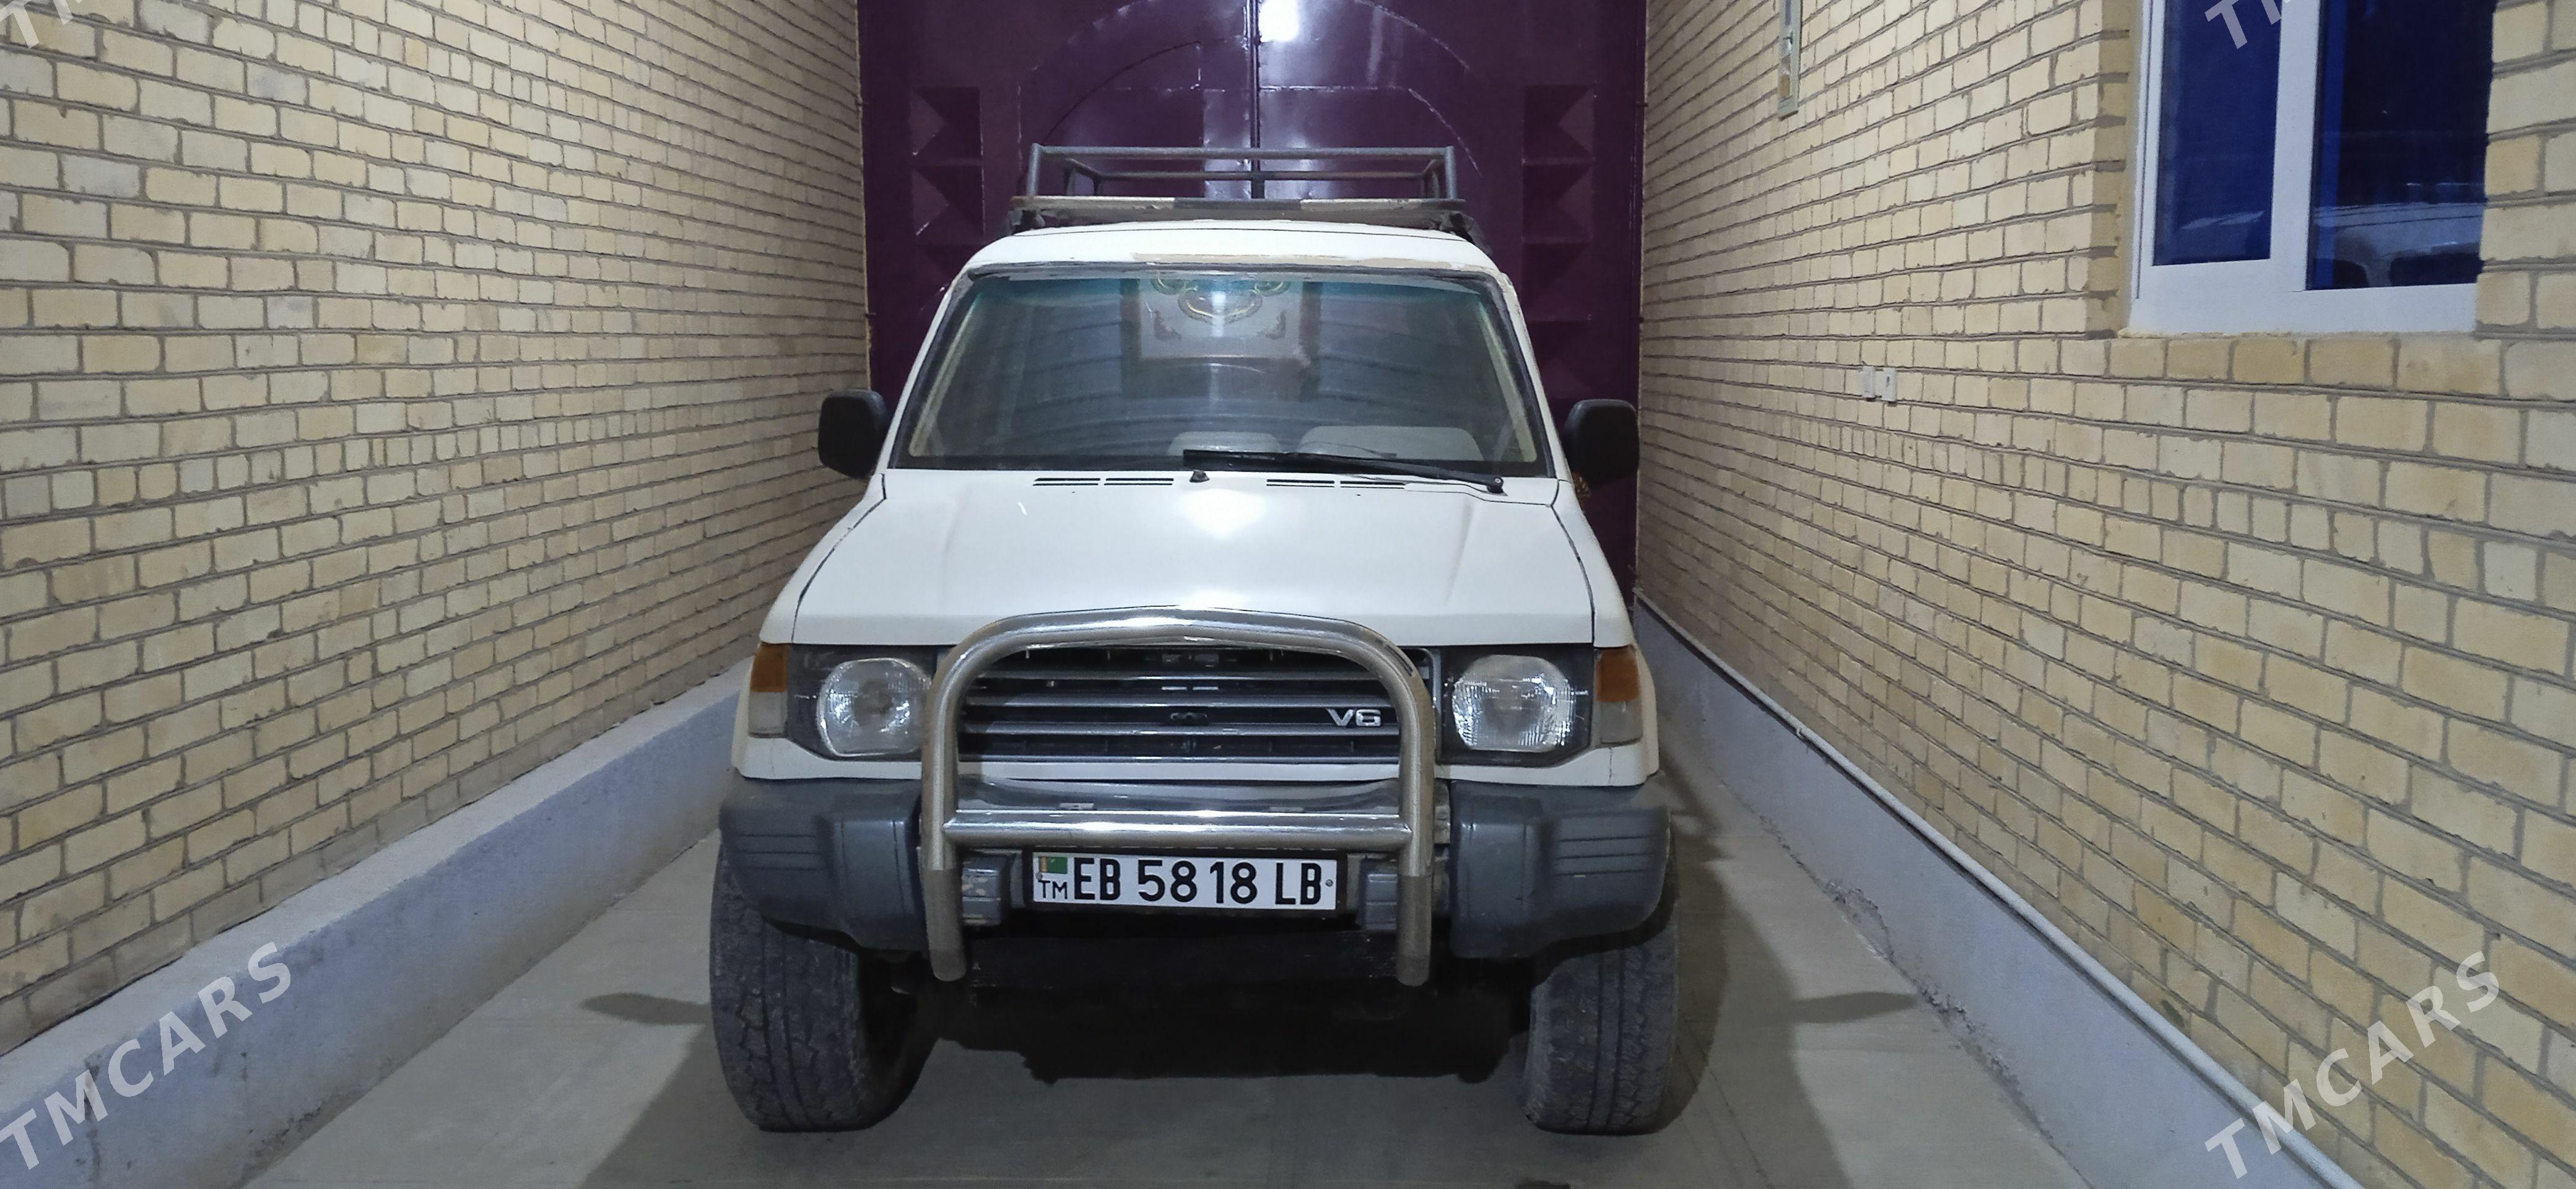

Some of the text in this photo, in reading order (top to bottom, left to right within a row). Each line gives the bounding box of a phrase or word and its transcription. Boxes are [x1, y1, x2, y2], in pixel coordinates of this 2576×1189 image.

[1325, 708, 1382, 727] V6
[1038, 880, 1068, 899] TM
[1073, 858, 1121, 900] EB
[1274, 863, 1321, 905] LB
